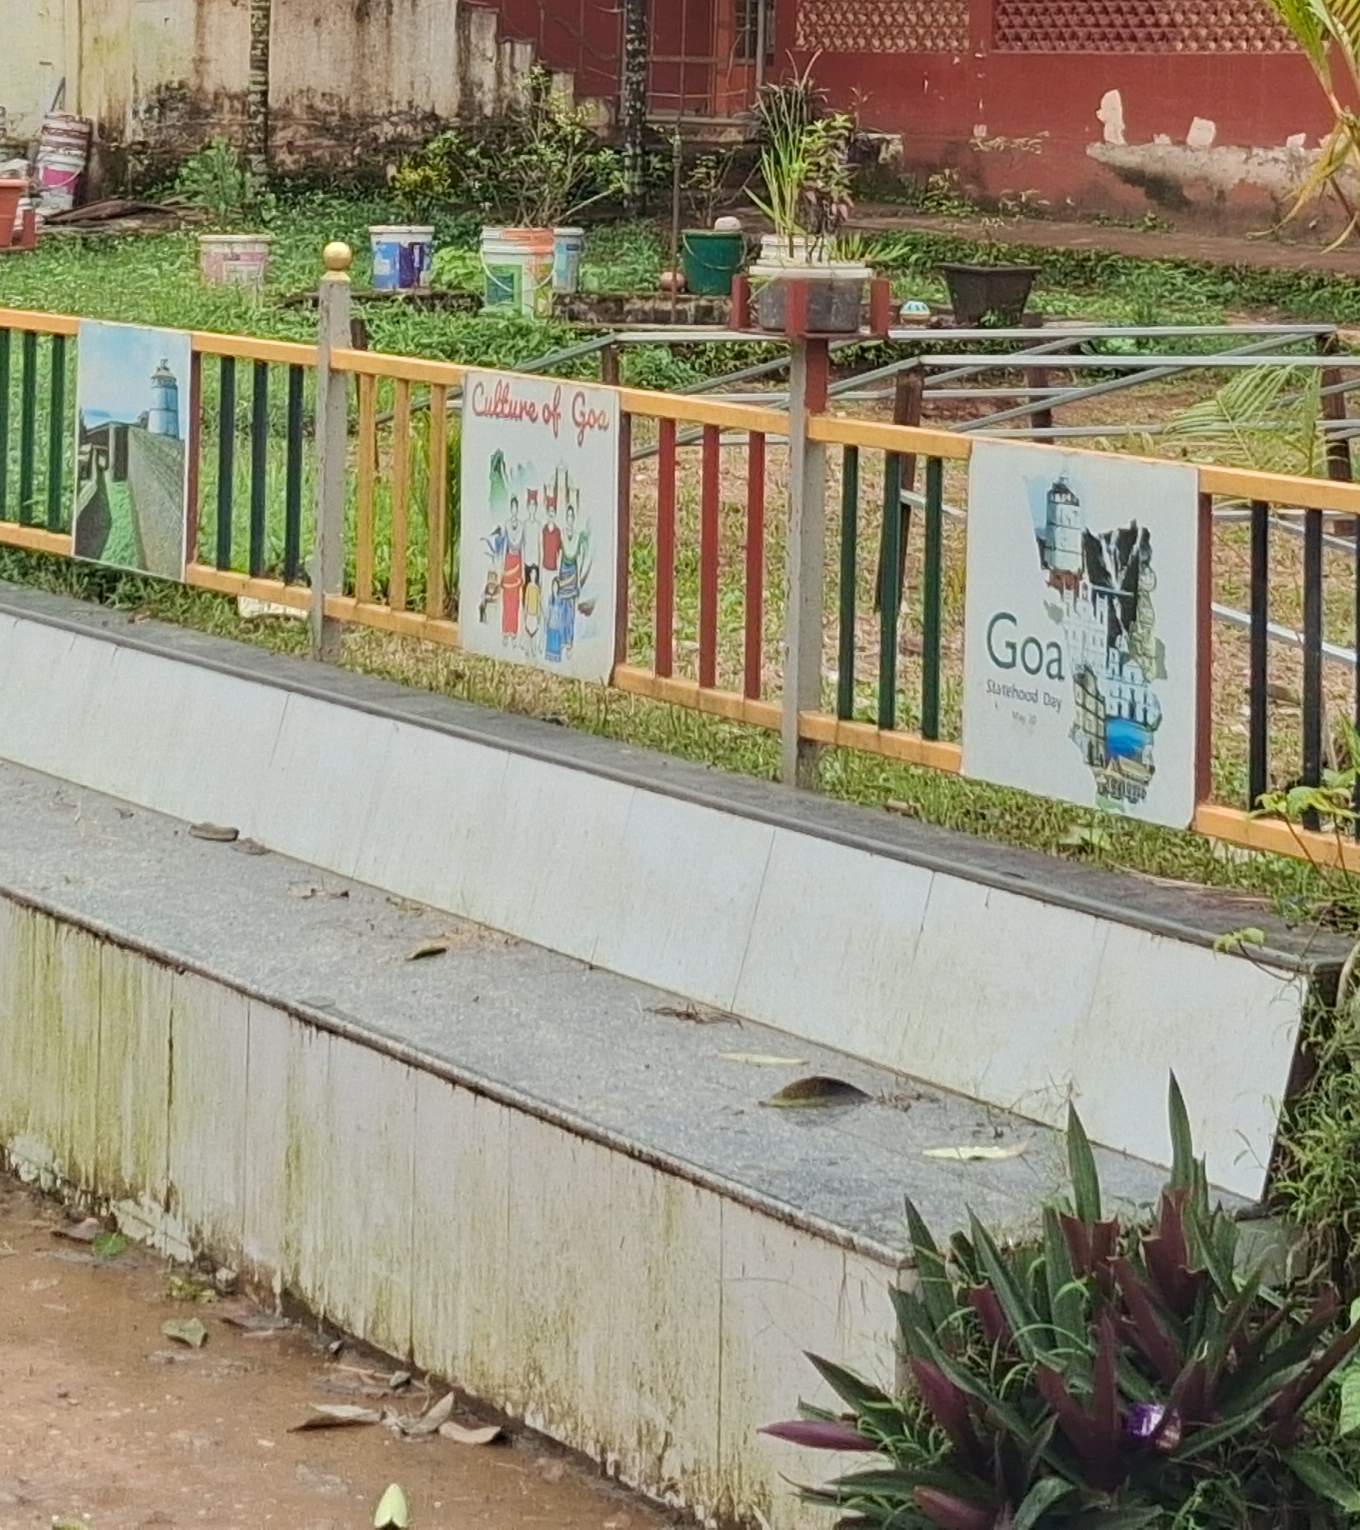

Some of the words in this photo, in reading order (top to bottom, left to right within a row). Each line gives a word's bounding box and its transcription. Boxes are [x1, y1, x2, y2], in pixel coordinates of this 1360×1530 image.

[472, 379, 538, 423] Culture
[542, 384, 562, 439] of
[572, 390, 610, 448] Goa
[986, 611, 1065, 682] Goa
[986, 678, 1039, 703] Statehood
[1043, 692, 1063, 713] Day
